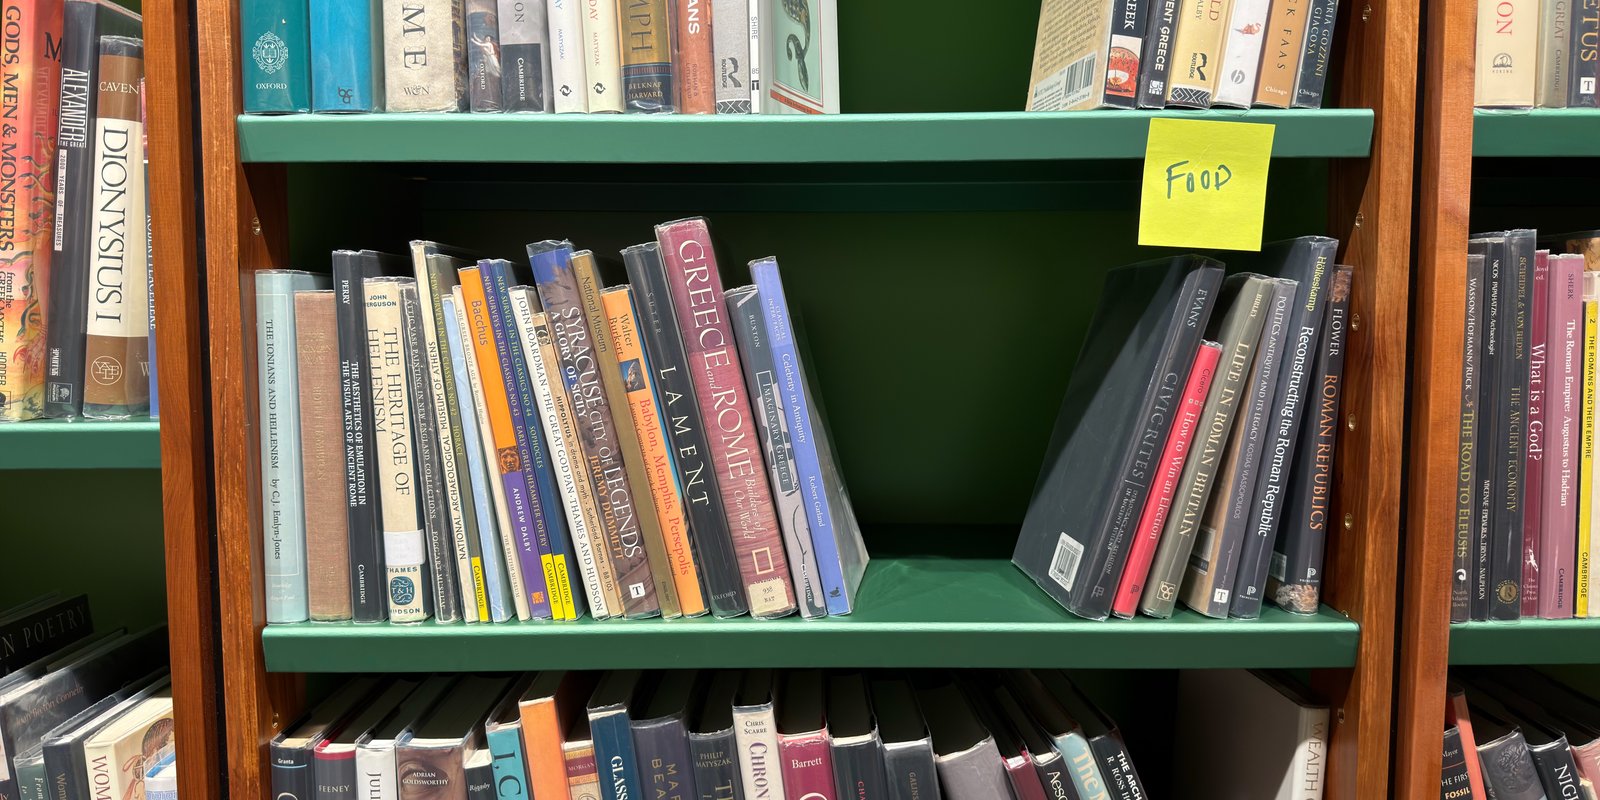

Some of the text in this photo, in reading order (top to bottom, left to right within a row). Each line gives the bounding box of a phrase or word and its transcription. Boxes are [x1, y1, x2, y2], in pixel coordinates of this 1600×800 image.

[751, 16, 759, 40] SHIRE
[1155, 26, 1170, 71] GREECE
[1276, 28, 1292, 70] FAAS
[1307, 7, 1323, 55] GIACOSA
[1189, 52, 1198, 80] ROUTLEDGE
[1315, 29, 1330, 77] GOZZINI
[99, 82, 140, 95] CAVEN
[255, 82, 288, 91] OXFORD
[516, 57, 526, 102] CAMBRIDGE
[628, 81, 662, 90] BELKNAP
[1265, 86, 1288, 96] Chicago
[0, 5, 22, 251] GODS, MEN MONSTERS
[60, 68, 88, 142] ALEXANDER
[55, 154, 67, 249] 2000 YEARS TREASURES
[1165, 160, 1233, 200] FOOD
[96, 126, 129, 305] DIONYSIUS
[341, 279, 351, 305] PERRY
[1305, 256, 1327, 313] Hölkeskamp
[1492, 258, 1500, 280] NICOS
[1517, 256, 1527, 300] SCHEIDEL
[1567, 273, 1575, 300] SHERK
[471, 300, 489, 347] Bacchus
[581, 276, 608, 354] National Museum
[619, 313, 634, 349] Walter
[647, 291, 663, 337] SUTER
[1186, 288, 1208, 329] EVANS
[1270, 295, 1288, 337] POLITICS
[608, 317, 625, 356] Burkert
[748, 314, 761, 350] BUXTON
[1328, 308, 1343, 357] FLOWER
[1464, 277, 1477, 391] WASSON/HOFMANN/RUCK
[367, 329, 387, 433] HELLENISM
[501, 294, 544, 469] SURVEYS CLASSICS SOPHOCLES
[555, 322, 588, 419] GLORY SICILY
[678, 239, 756, 481] GREECE ROME
[1197, 368, 1211, 394] Cicero
[1227, 341, 1250, 382] LIFE
[384, 327, 410, 496] THE HERITAGE OF
[487, 294, 548, 547] SURVEYS CLASSICS HEXAMETER POETRY
[556, 396, 573, 438] HIPPOLYTUS
[1528, 343, 1545, 461] What God?
[1559, 334, 1576, 508] Roman Empire: Augustus Hadrian
[1584, 351, 1595, 460] ROMANS THEIR EMPIRE
[266, 319, 282, 560] THE IONIANS AND HELLENISM Emlyn-Jones
[343, 378, 358, 508] VISUAL ARTS ANCIENT ROME
[352, 380, 367, 493] AESTHETICS EMULATION
[452, 425, 463, 456] HORACE
[562, 306, 643, 560] SYRACUSE CITY LEGENDS
[658, 364, 711, 508] LAMENT
[761, 381, 790, 485] IMAGINARY GREECE
[782, 352, 826, 528] Celebrity Antiquity Garland
[1132, 372, 1179, 480] CIVIC RITES
[1200, 411, 1228, 467] ROMAN
[1257, 325, 1316, 538] Reconstructing Roman Republic
[428, 341, 468, 560] NATIONAL ARCHAEOLOGICAL MUSEUM ATHENS
[515, 296, 604, 612] JOHN BOARDMAN THE GREAT GOD THAMES HUDSON
[1245, 443, 1257, 468] KOSTAS
[1309, 373, 1338, 532] ROMAN REPUBLICS
[1505, 386, 1521, 514] THE ANCIENT ECONOMY
[639, 398, 659, 449] Babylon,
[653, 454, 677, 515] Memphis,
[668, 516, 691, 577] Persepolis
[1149, 412, 1196, 541] How Win Election
[1232, 468, 1250, 520] VLASSOPOULOS
[1456, 409, 1476, 559] THE ROAD TO ELEUSIS
[512, 487, 532, 553] ANDREW DALBY
[588, 455, 625, 560] JEREMY DUMMETT
[1178, 470, 1210, 538] BRITAIN
[358, 564, 367, 605] CAMBRIDGE
[473, 565, 485, 609] CAMBRIDGE
[545, 562, 559, 605] CAMBRIDGE
[557, 562, 571, 605] CAMBRIDGE
[710, 589, 738, 602] OXFORD
[1556, 567, 1566, 609] CAMBRIDGE
[1580, 551, 1589, 599] CAMBRIDGE
[22, 604, 88, 649] POETRY
[744, 727, 768, 736] SCARRE
[745, 720, 765, 728] CHRIS
[277, 758, 295, 766] Granta
[695, 759, 732, 769] MATYSZAK
[699, 751, 724, 760] PHILIP
[791, 756, 823, 770] Barrett
[1072, 747, 1098, 792] The
[1116, 751, 1131, 773] THE
[1304, 721, 1325, 792] WEALTH
[318, 784, 351, 794] FEENEY
[402, 778, 449, 787] GOLDSWORTHY
[1444, 786, 1471, 800] FOSSIL
